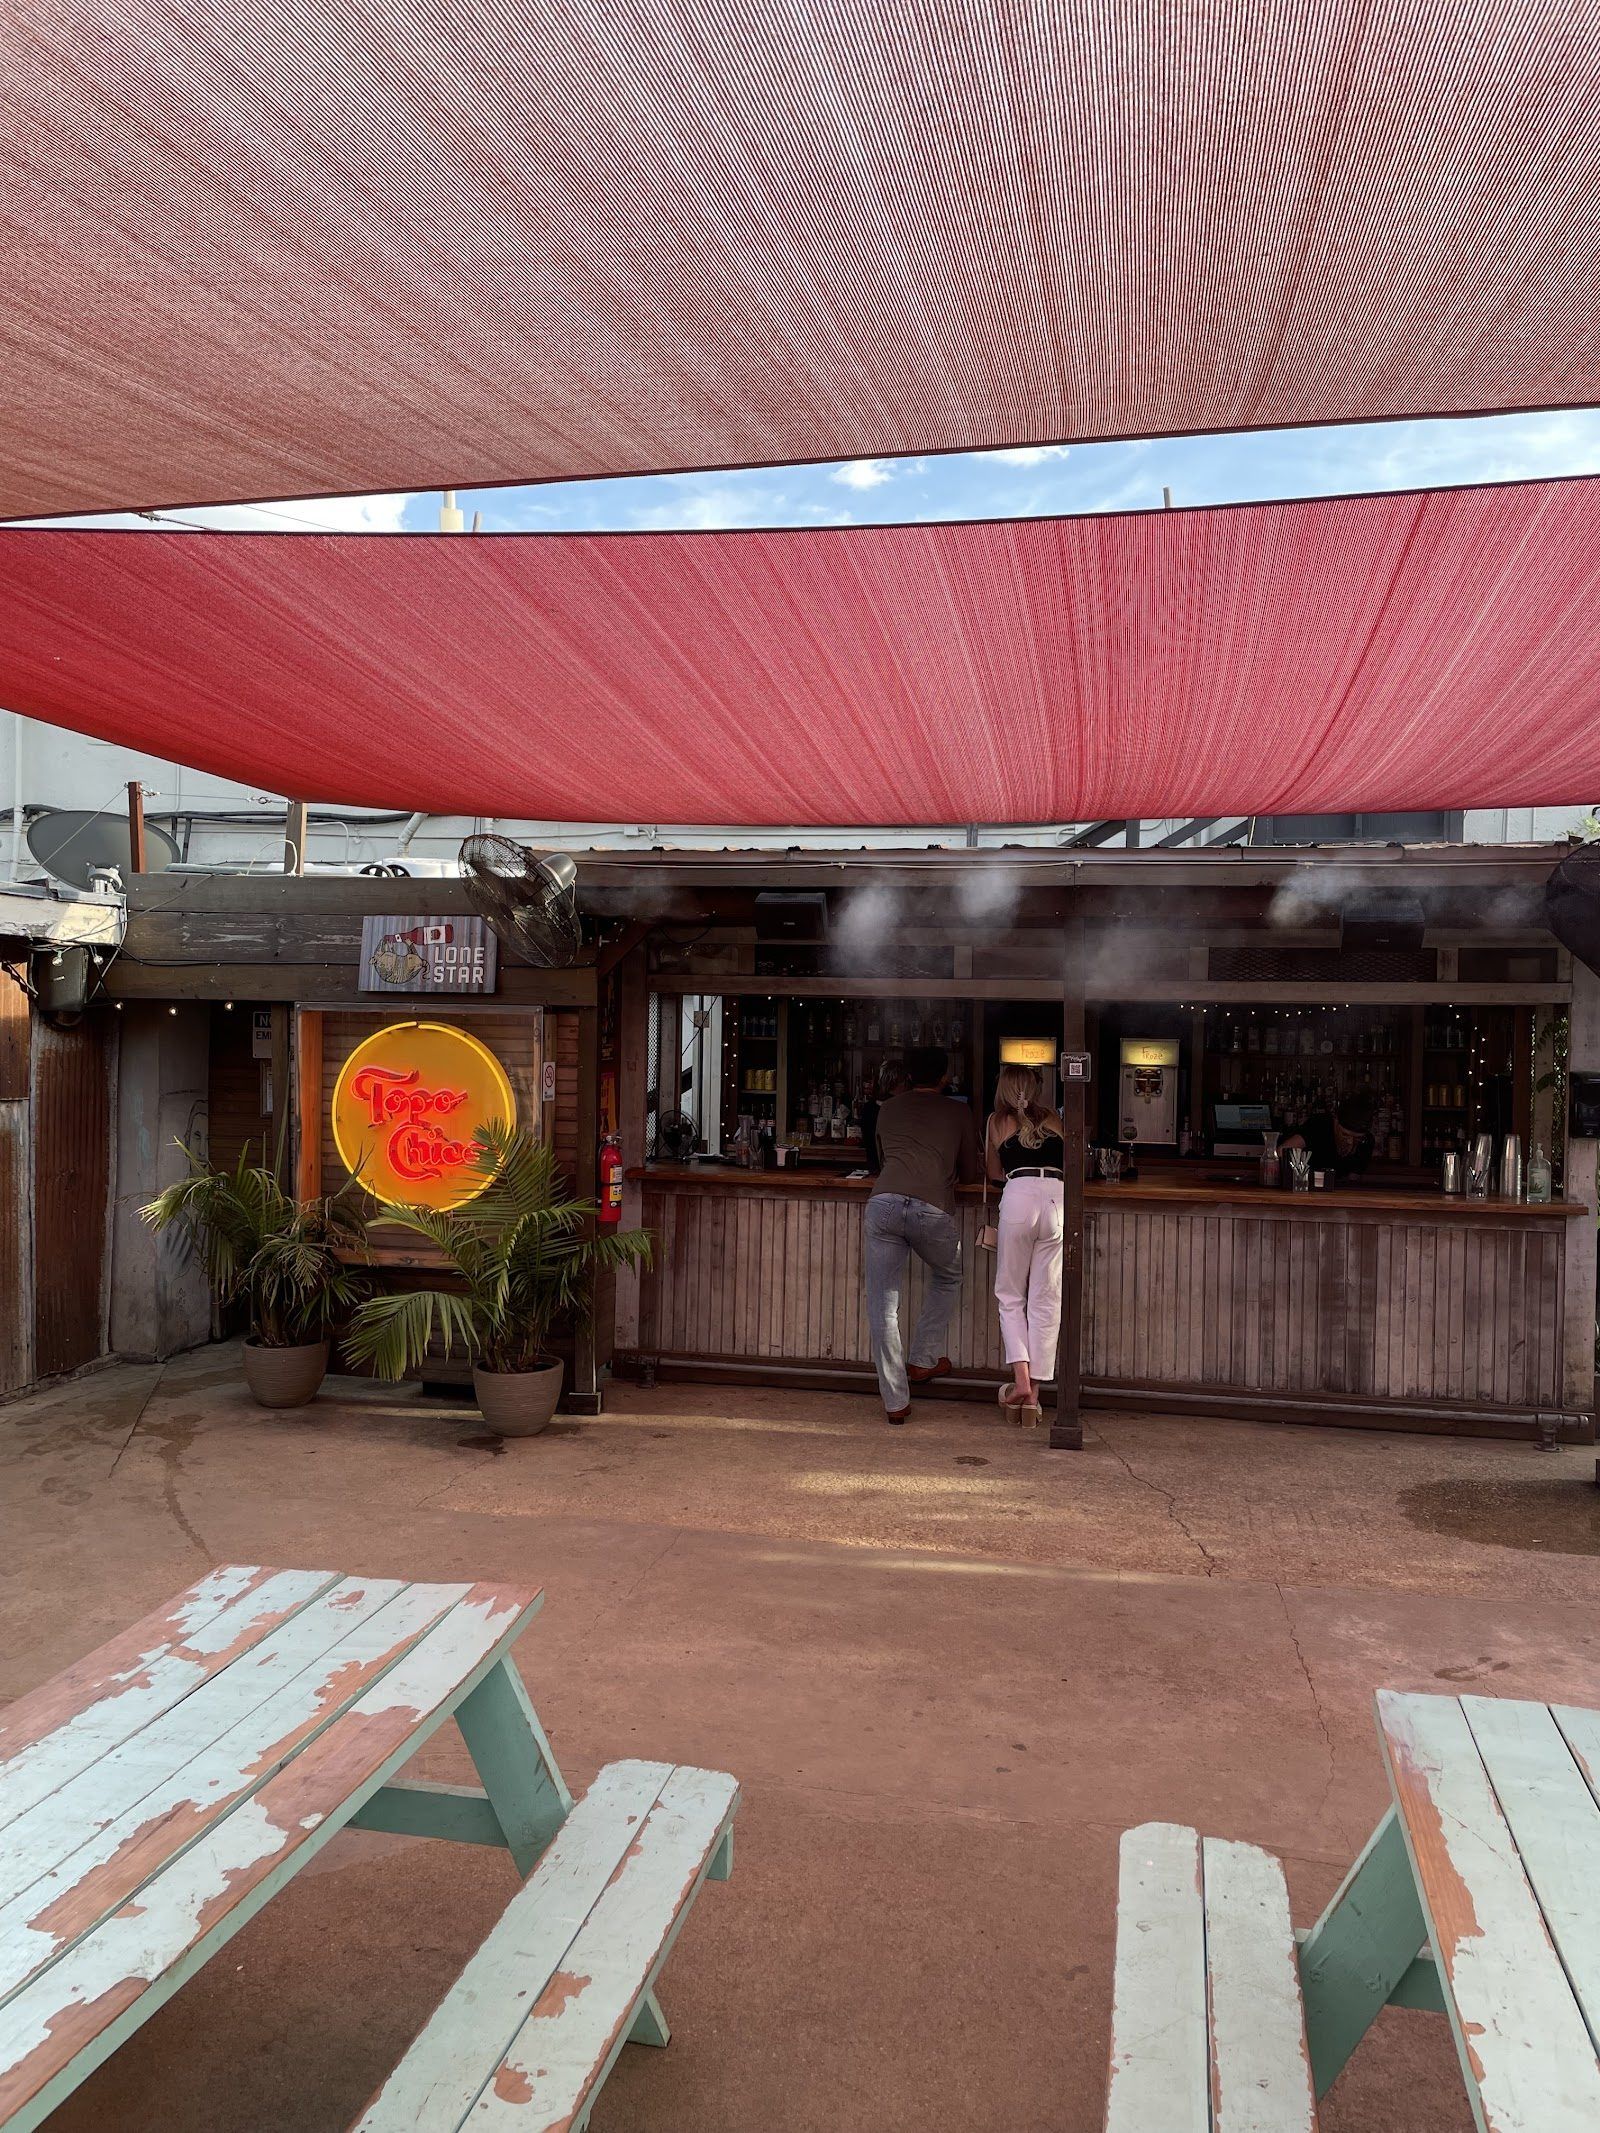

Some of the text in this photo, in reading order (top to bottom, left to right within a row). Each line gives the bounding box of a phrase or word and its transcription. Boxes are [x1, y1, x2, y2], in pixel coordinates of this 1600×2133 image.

[434, 946, 485, 964] LONE
[433, 966, 485, 984] STAR
[350, 1065, 469, 1127] Topo
[387, 1121, 488, 1181] Chico
